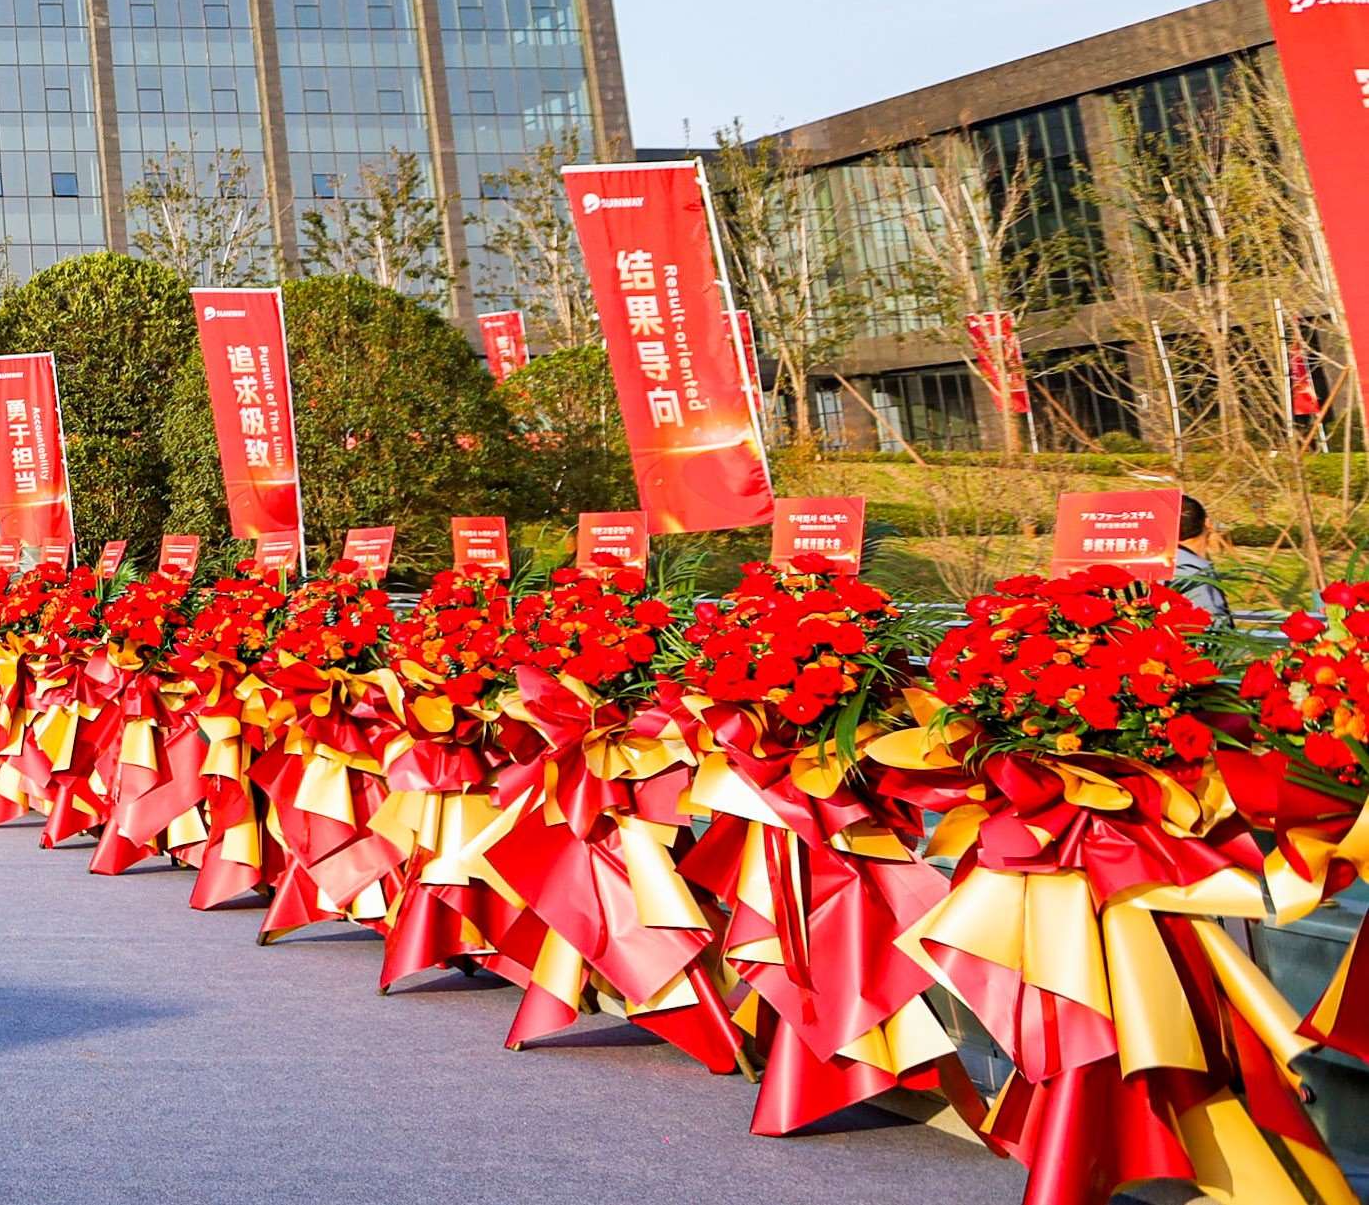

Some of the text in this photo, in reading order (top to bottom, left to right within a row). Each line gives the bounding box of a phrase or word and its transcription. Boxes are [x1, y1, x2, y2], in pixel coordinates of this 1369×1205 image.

[600, 196, 644, 208] SUNWAY
[616, 249, 684, 429] 结果导向
[663, 264, 708, 412] Result-oriented
[6, 398, 37, 494] 勇于担当
[32, 406, 49, 481] Accountability
[226, 345, 271, 468] 追求极致
[258, 346, 286, 470] Pursuit of The Limit
